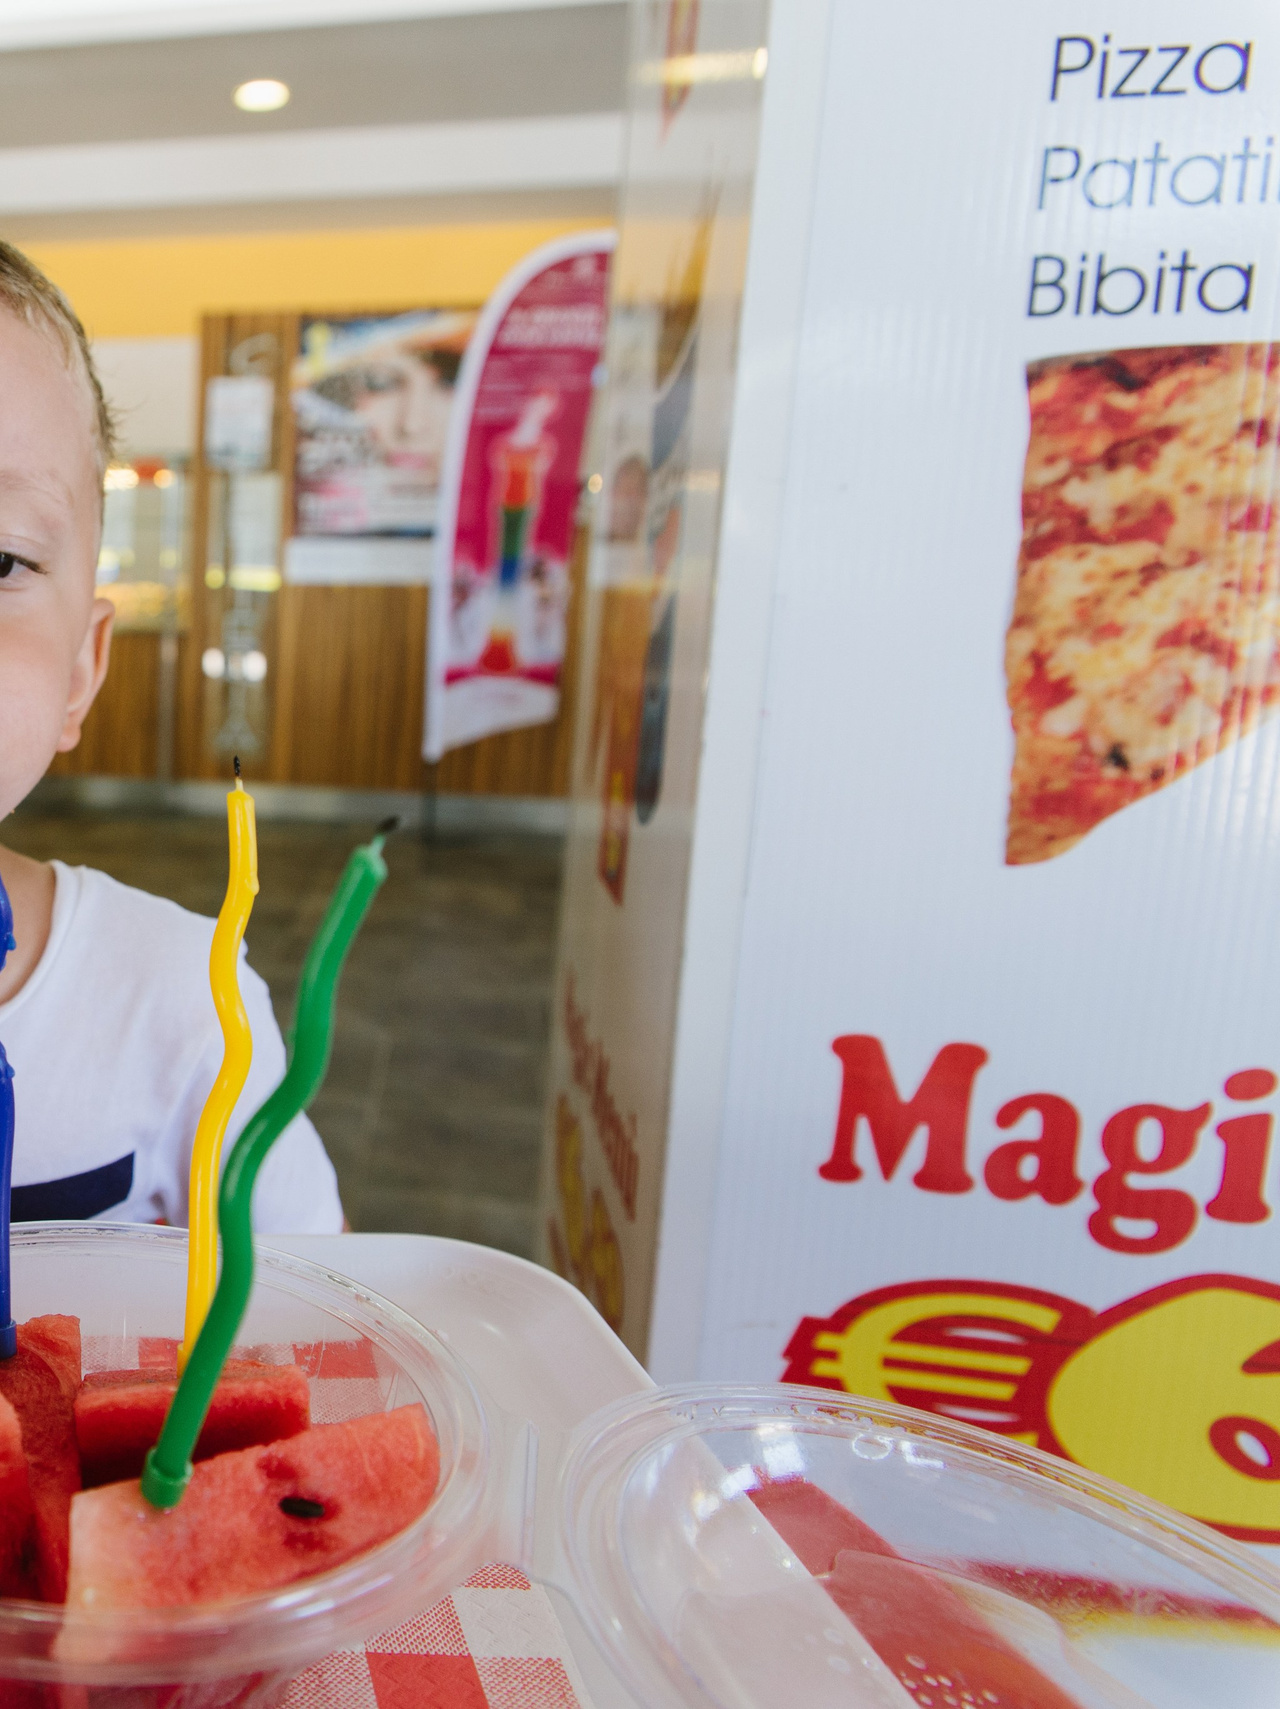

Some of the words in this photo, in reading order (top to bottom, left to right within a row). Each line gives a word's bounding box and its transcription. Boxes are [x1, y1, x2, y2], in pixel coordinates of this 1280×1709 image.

[1048, 33, 1254, 102] Pizza
[1036, 135, 1280, 211] Patati
[1025, 249, 1256, 318] Bibita
